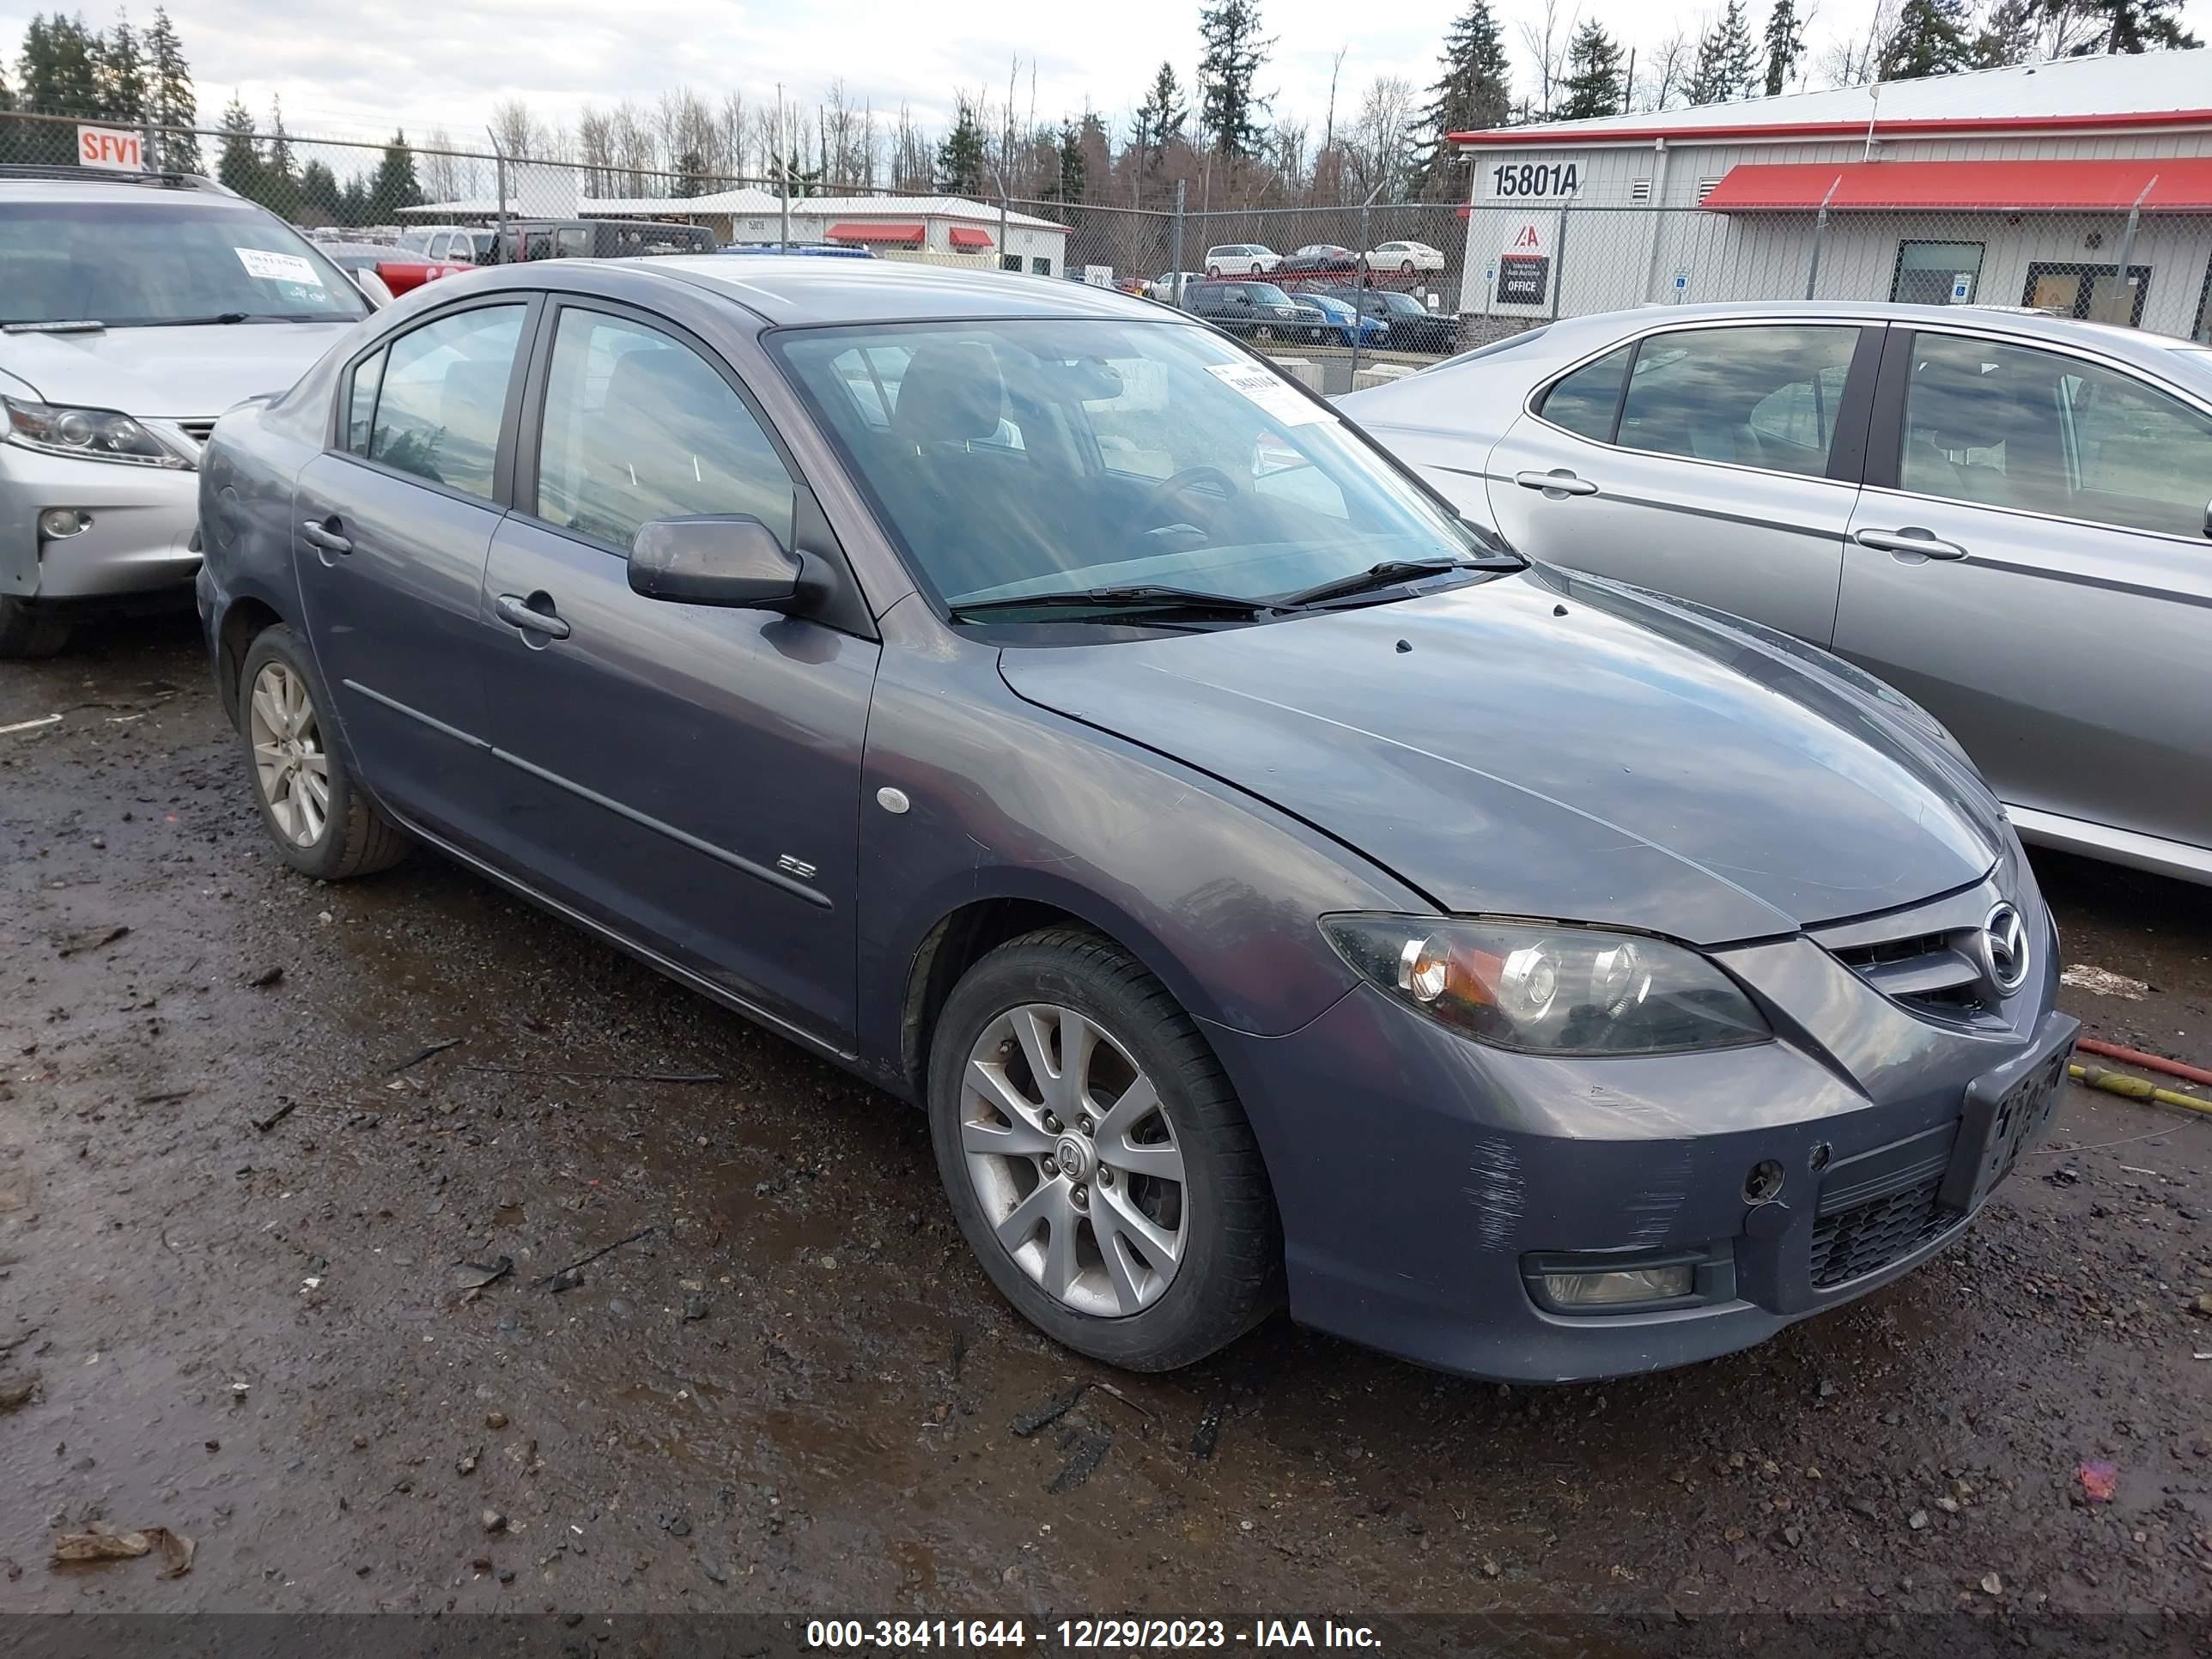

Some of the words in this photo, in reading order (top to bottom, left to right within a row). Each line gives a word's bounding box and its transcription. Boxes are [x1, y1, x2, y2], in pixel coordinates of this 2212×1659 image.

[82, 131, 137, 166] SFV1
[1493, 163, 1577, 196] 15801A
[1508, 281, 1536, 292] OFFICE
